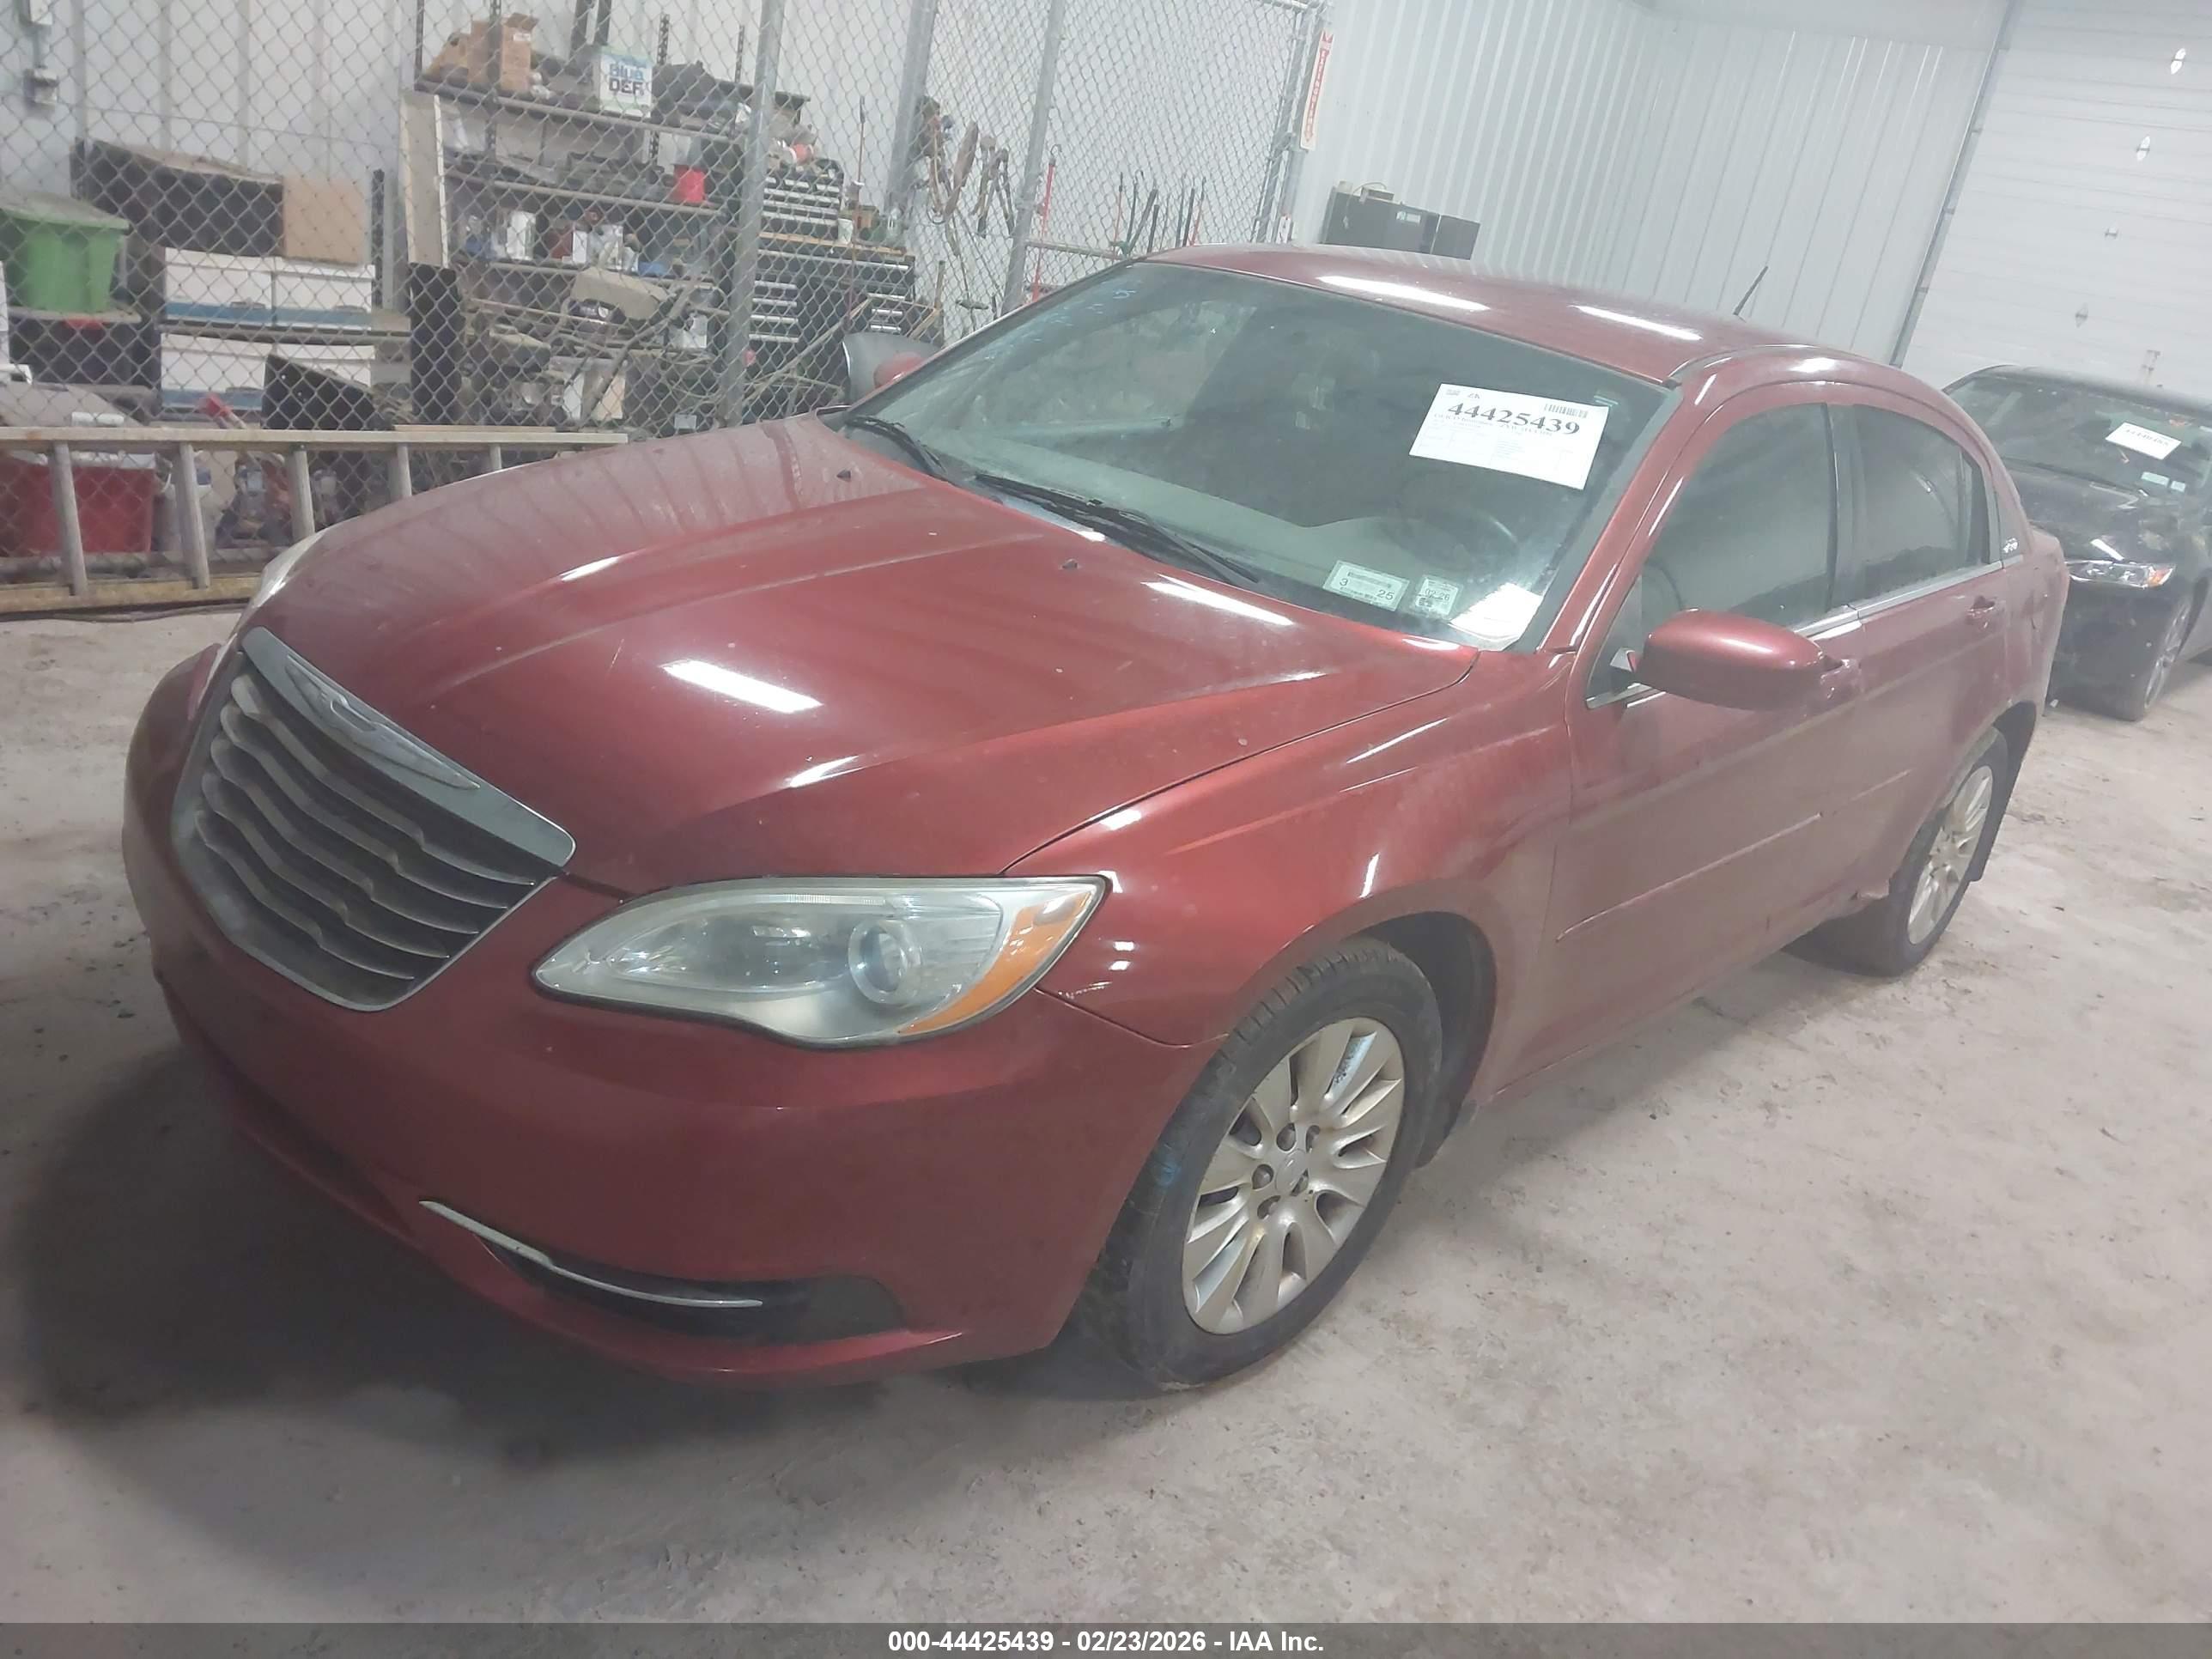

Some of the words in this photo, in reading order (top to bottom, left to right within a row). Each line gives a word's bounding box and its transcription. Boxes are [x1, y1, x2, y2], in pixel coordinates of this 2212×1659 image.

[609, 77, 642, 94] DEF
[1448, 403, 1580, 434] 44425439
[1340, 578, 1349, 586] 3
[1376, 589, 1395, 600] 25
